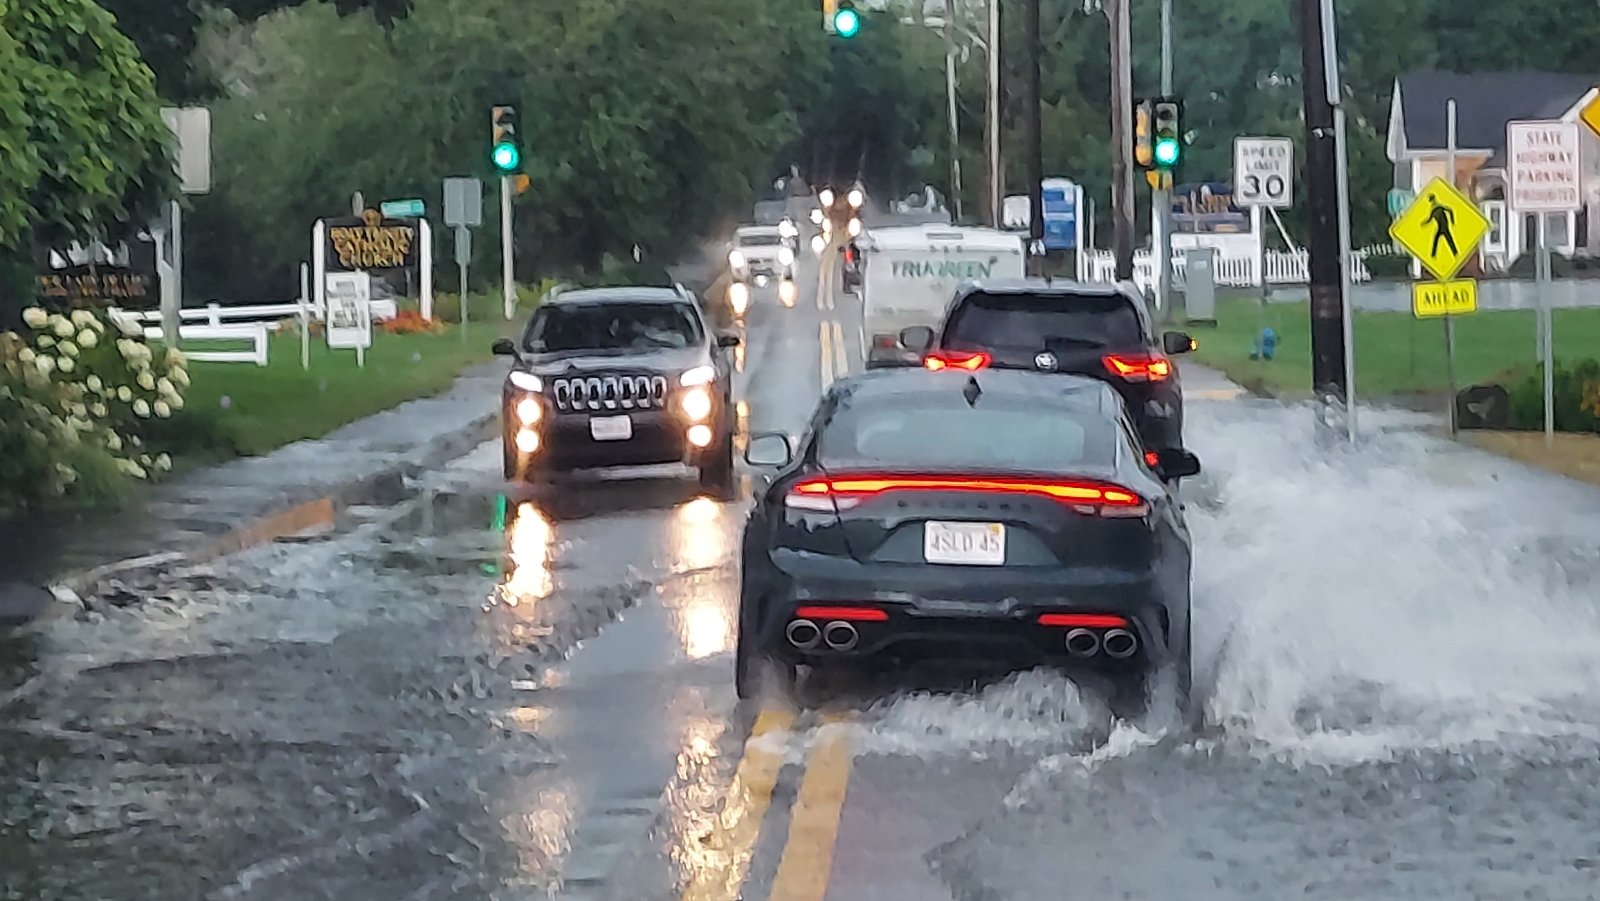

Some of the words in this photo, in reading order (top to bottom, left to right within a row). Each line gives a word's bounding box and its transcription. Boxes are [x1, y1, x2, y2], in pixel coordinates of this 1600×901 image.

[1526, 131, 1563, 147] STATE
[1243, 146, 1286, 157] SPEED
[1245, 160, 1280, 172] LIMIT
[1517, 169, 1574, 183] PARKING
[1243, 174, 1285, 198] 30
[340, 251, 404, 268] CHURCH
[1424, 289, 1469, 307] AHEAD
